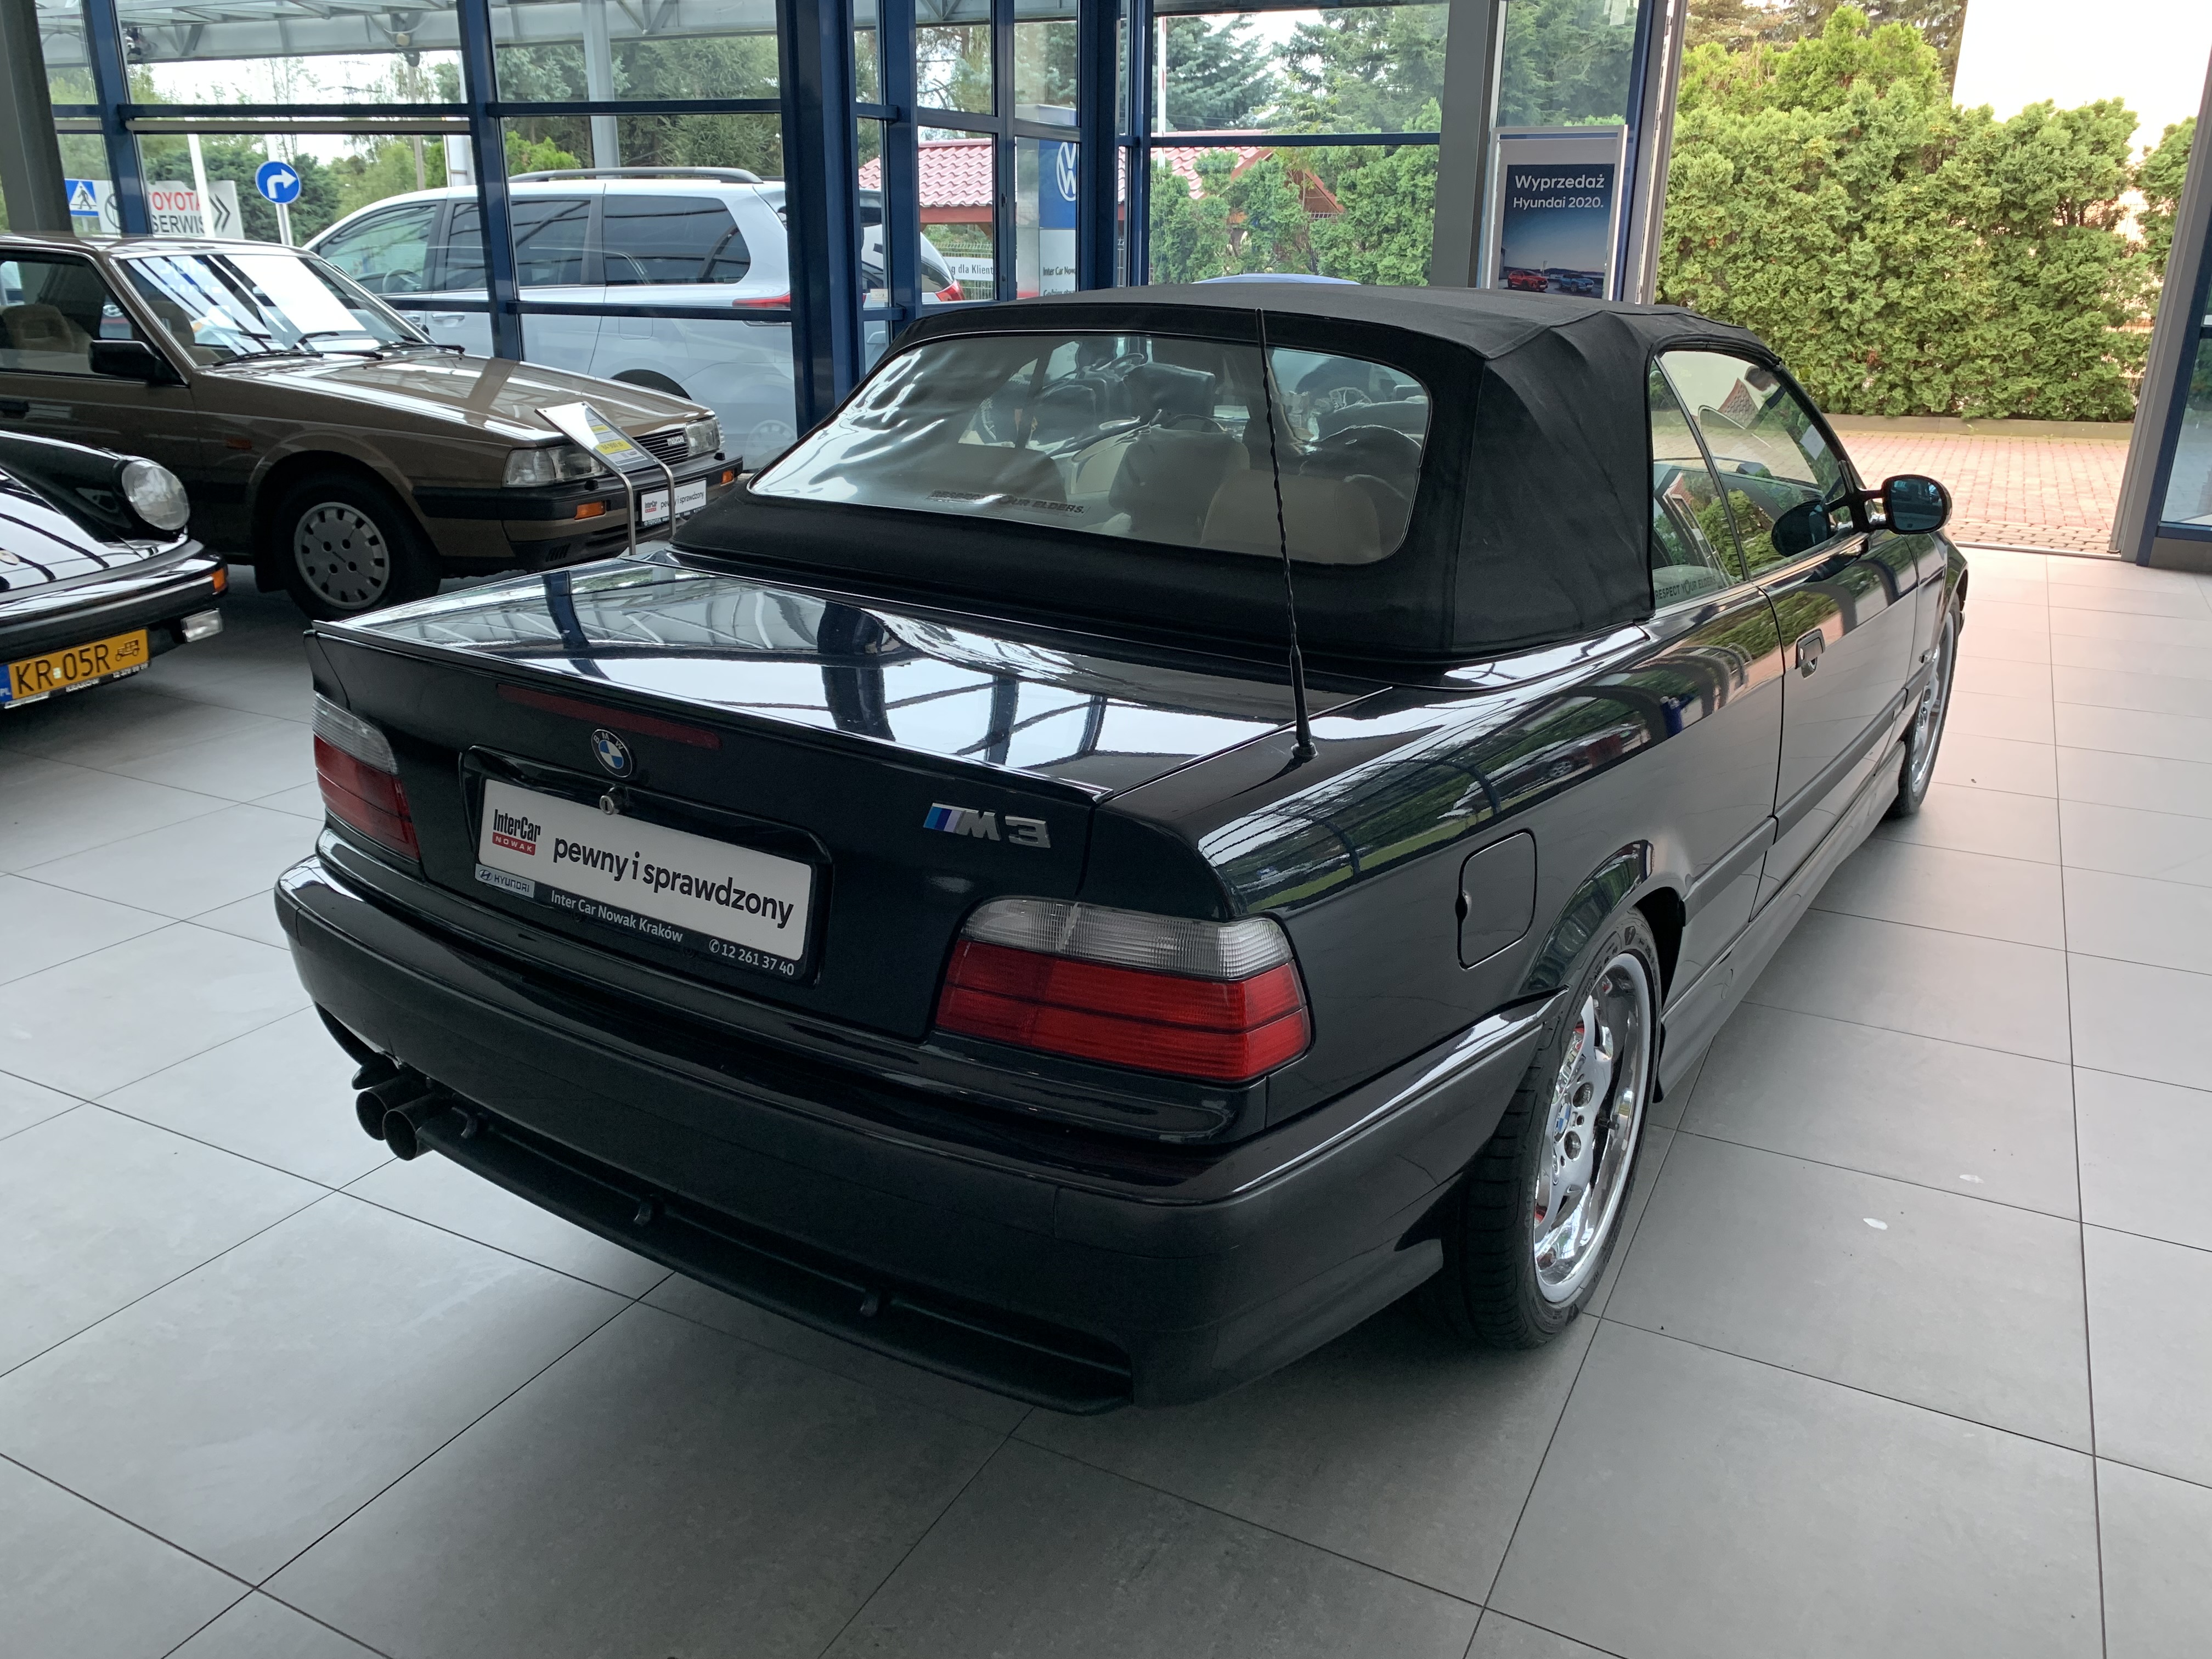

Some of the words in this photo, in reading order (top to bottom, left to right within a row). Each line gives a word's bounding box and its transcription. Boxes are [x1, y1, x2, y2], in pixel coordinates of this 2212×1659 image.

[1515, 174, 1605, 191] Wyprzedaż
[1513, 196, 1566, 210] Hyundai
[1567, 196, 1604, 208] 2020.
[958, 264, 969, 274] dla
[1043, 267, 1054, 276] Inter
[679, 492, 704, 505] sprawdzony
[1032, 501, 1085, 514] ELDERS.
[1655, 584, 1680, 601] RESPECT
[1680, 579, 1698, 595] YOUR
[15, 659, 54, 695] KR
[63, 644, 111, 681] 05R
[0, 687, 11, 697] PL
[593, 732, 624, 751] BMW
[493, 809, 541, 843] InterCar
[495, 836, 533, 853] NOWAK
[494, 874, 529, 893] HYUNDAI
[552, 837, 629, 882] pewny
[631, 851, 641, 880] i
[642, 864, 794, 929] sprawdzony
[551, 890, 577, 909] Inter
[578, 899, 596, 916] Car
[598, 905, 636, 929] Nowak
[639, 917, 684, 943] Kraków
[721, 943, 736, 959] 12
[737, 948, 759, 966] 261
[761, 955, 777, 970] 37
[778, 960, 795, 977] 40
